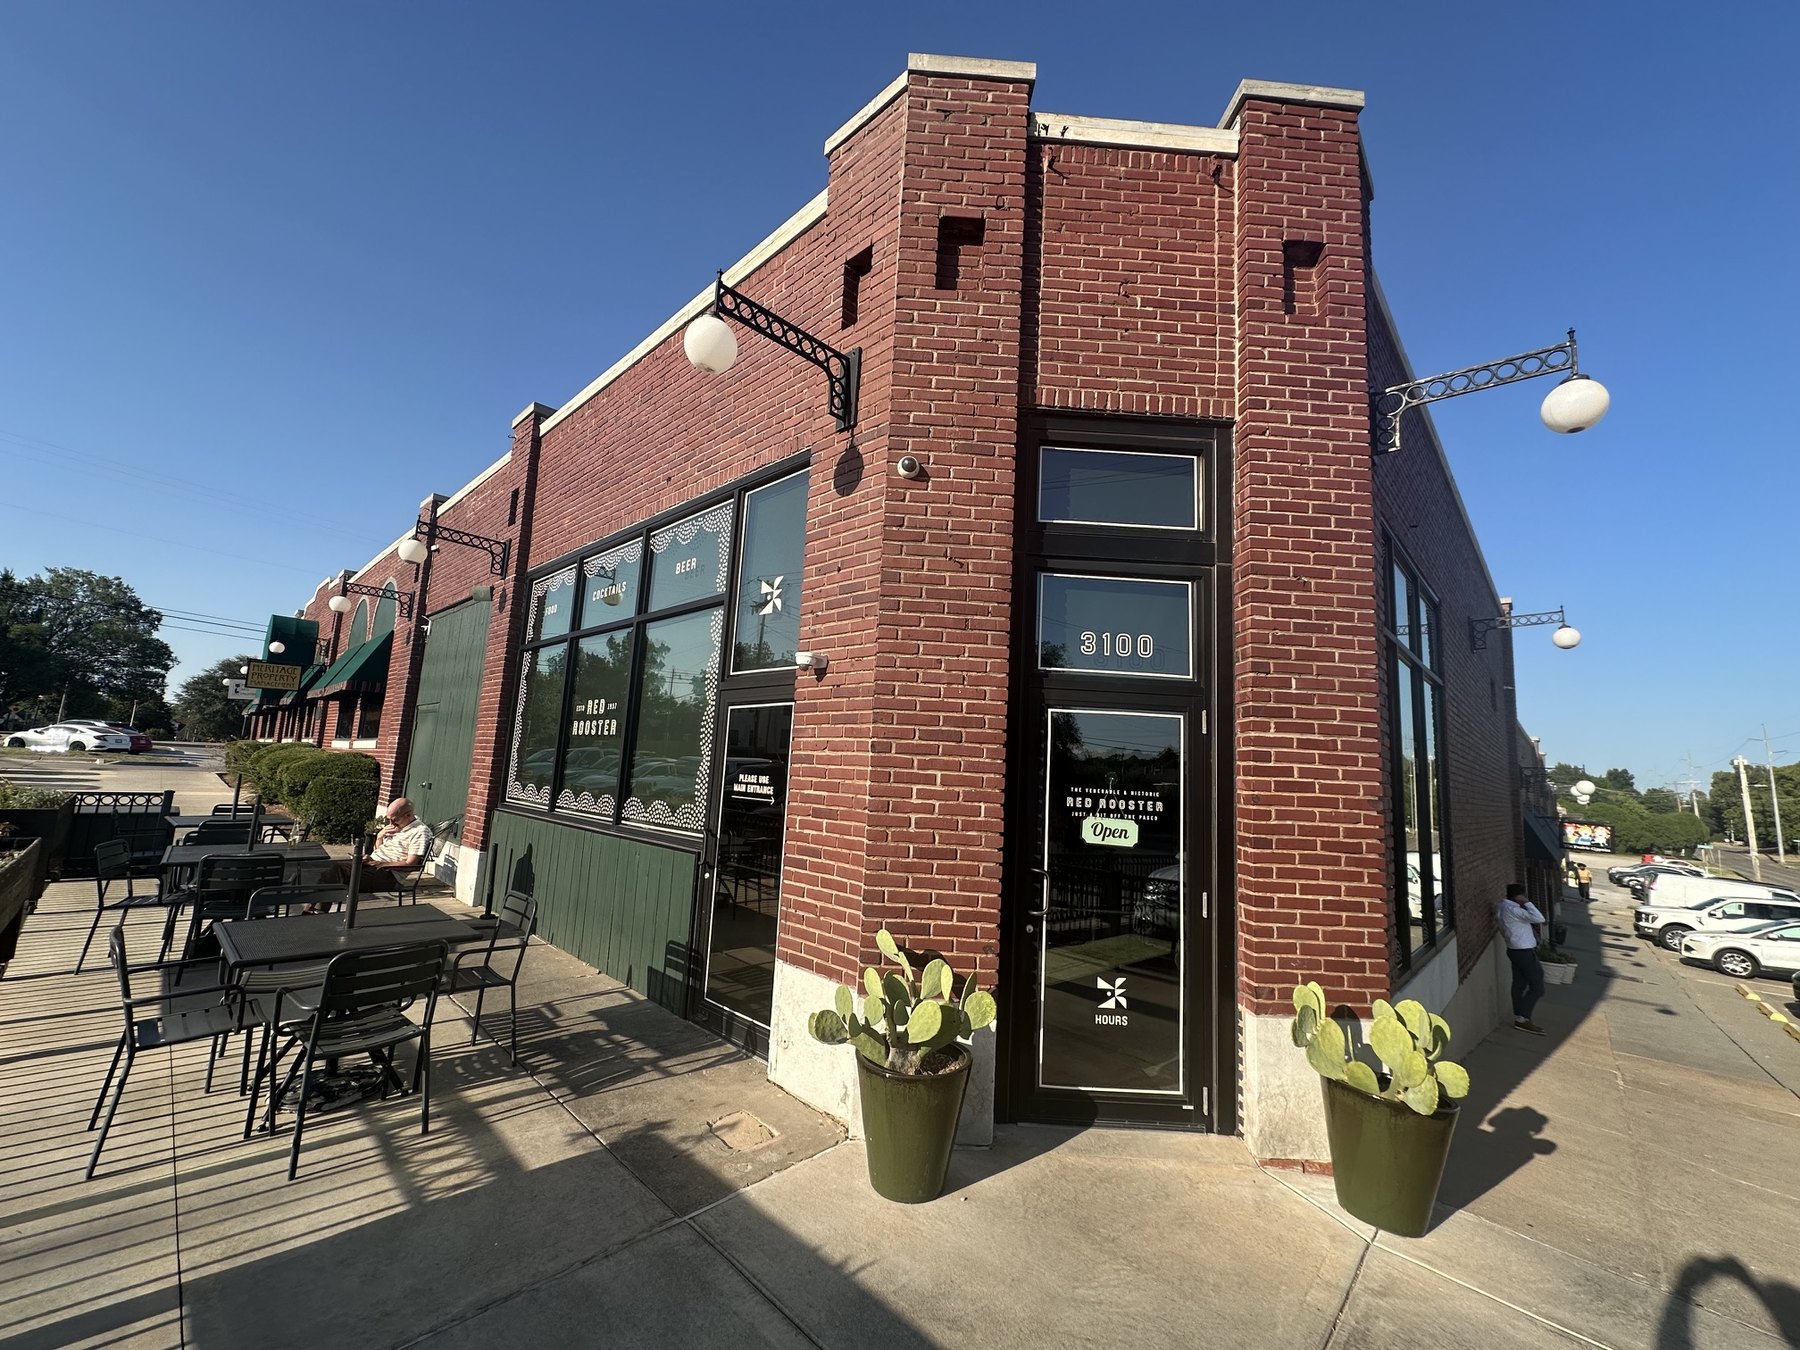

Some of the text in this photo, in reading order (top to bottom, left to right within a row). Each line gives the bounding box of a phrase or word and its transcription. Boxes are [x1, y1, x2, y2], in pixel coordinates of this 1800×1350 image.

[675, 557, 697, 574] BEER
[592, 581, 627, 601] COCKTAILS
[544, 604, 558, 616] FOOD
[1080, 631, 1153, 658] 3100
[252, 664, 297, 675] HERITAGE
[251, 672, 297, 682] PROPERTY
[250, 680, 295, 688] MANAGEMENT
[586, 698, 605, 715] RED
[572, 719, 617, 736] ROOSTER
[739, 774, 769, 784] PLEASE USE
[733, 783, 774, 795] MAIN ENTRANCE
[1066, 796, 1163, 811] RED ROOSTER
[1091, 822, 1129, 841] Open
[1095, 1014, 1128, 1026] HOURS
